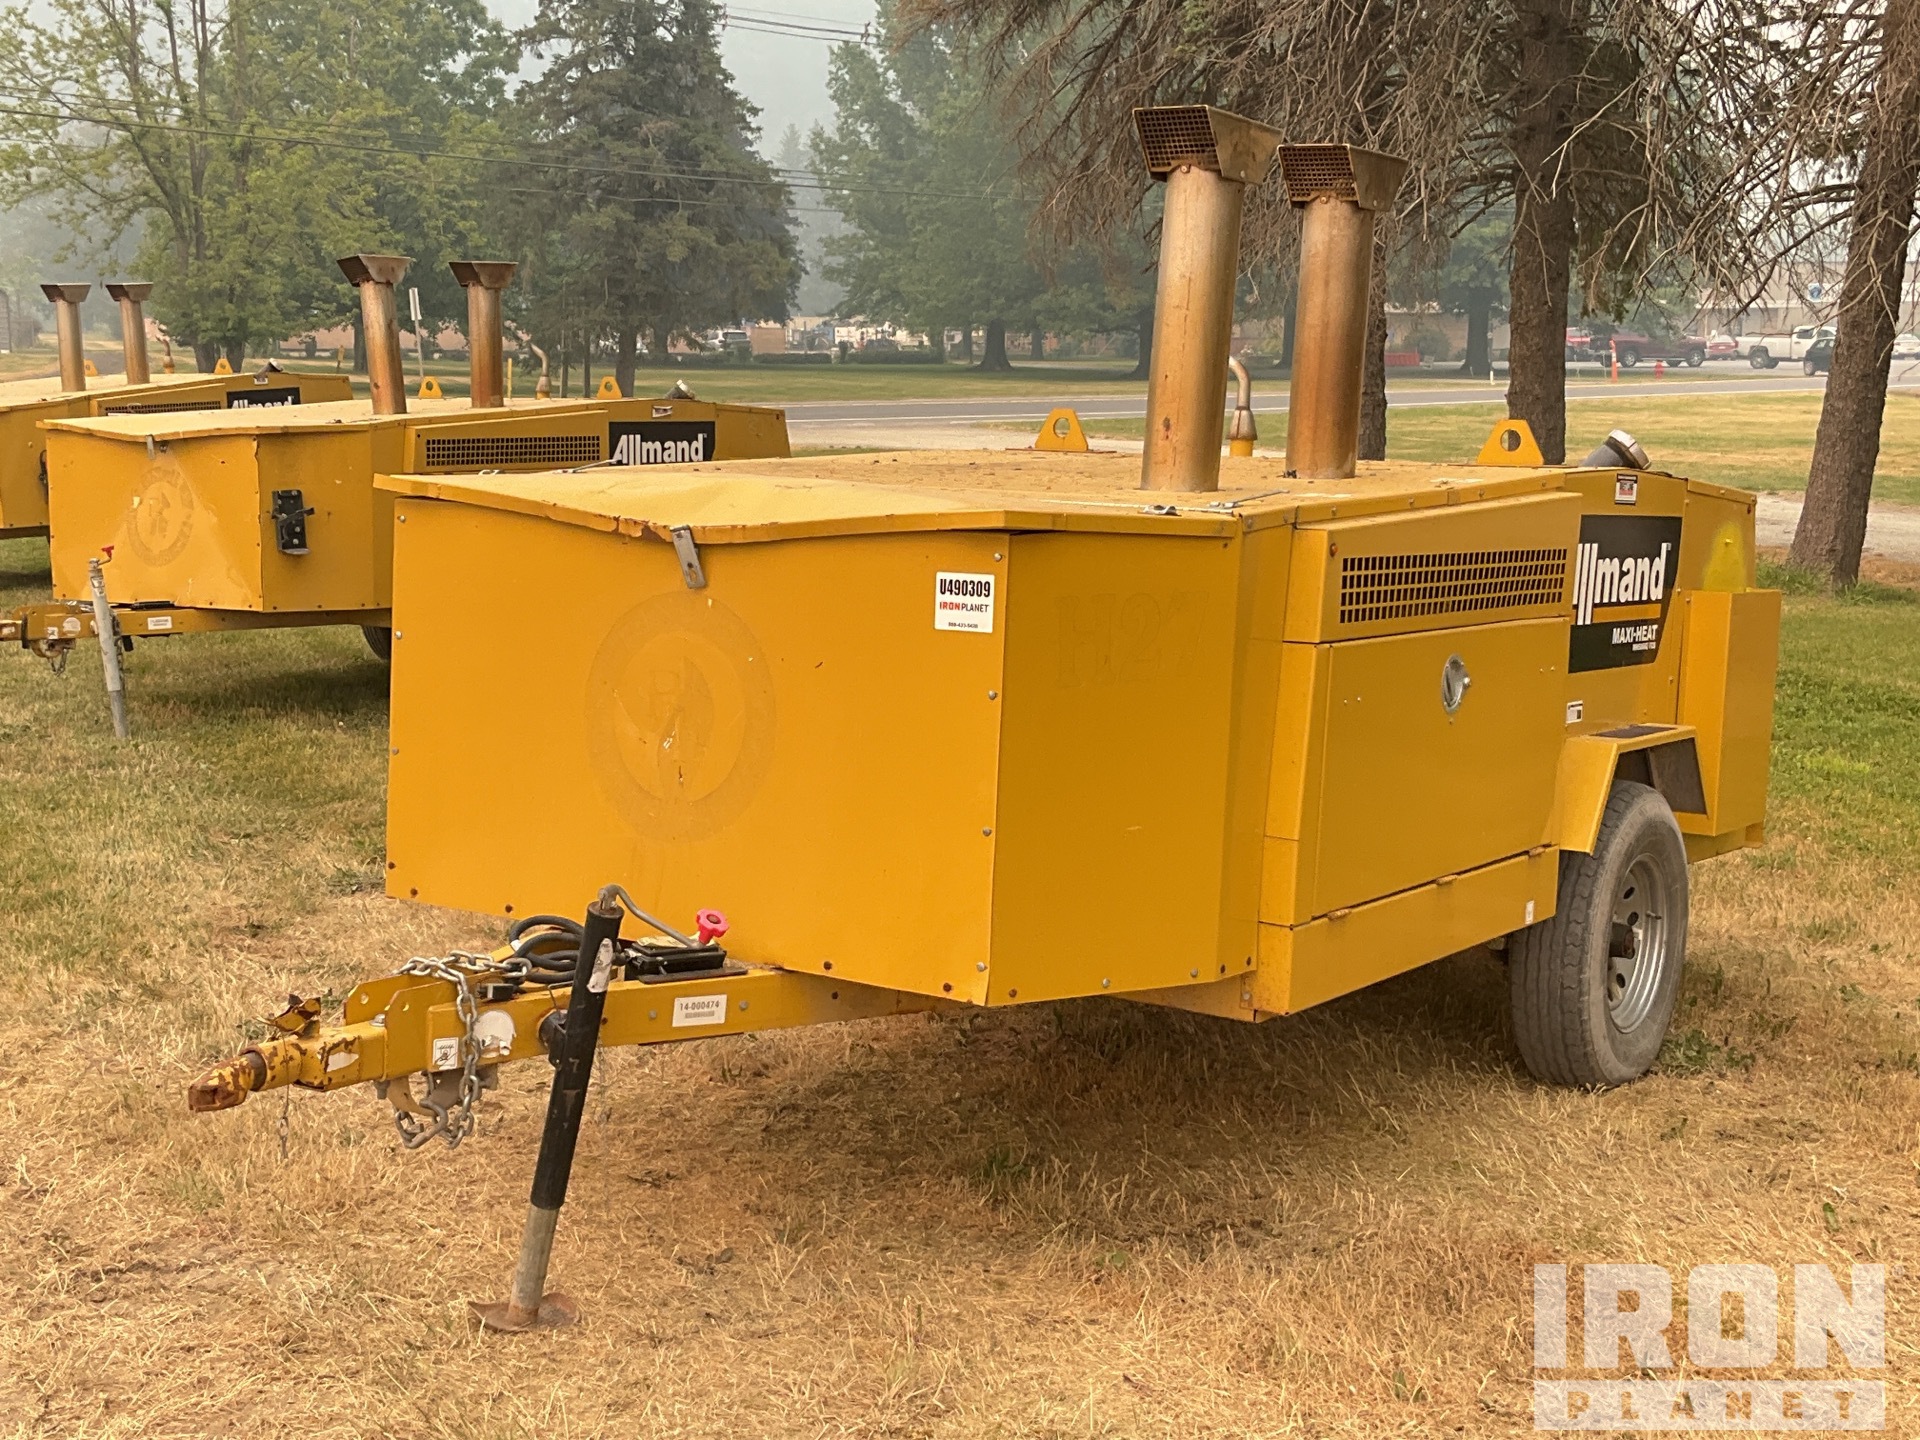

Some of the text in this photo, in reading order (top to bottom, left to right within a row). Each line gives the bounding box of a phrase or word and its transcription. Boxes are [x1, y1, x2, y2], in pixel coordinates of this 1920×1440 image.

[611, 432, 704, 466] Allmand
[939, 578, 991, 598] U490309
[1611, 624, 1658, 645] MAXI-HEAT
[680, 1000, 720, 1011] 14-000474
